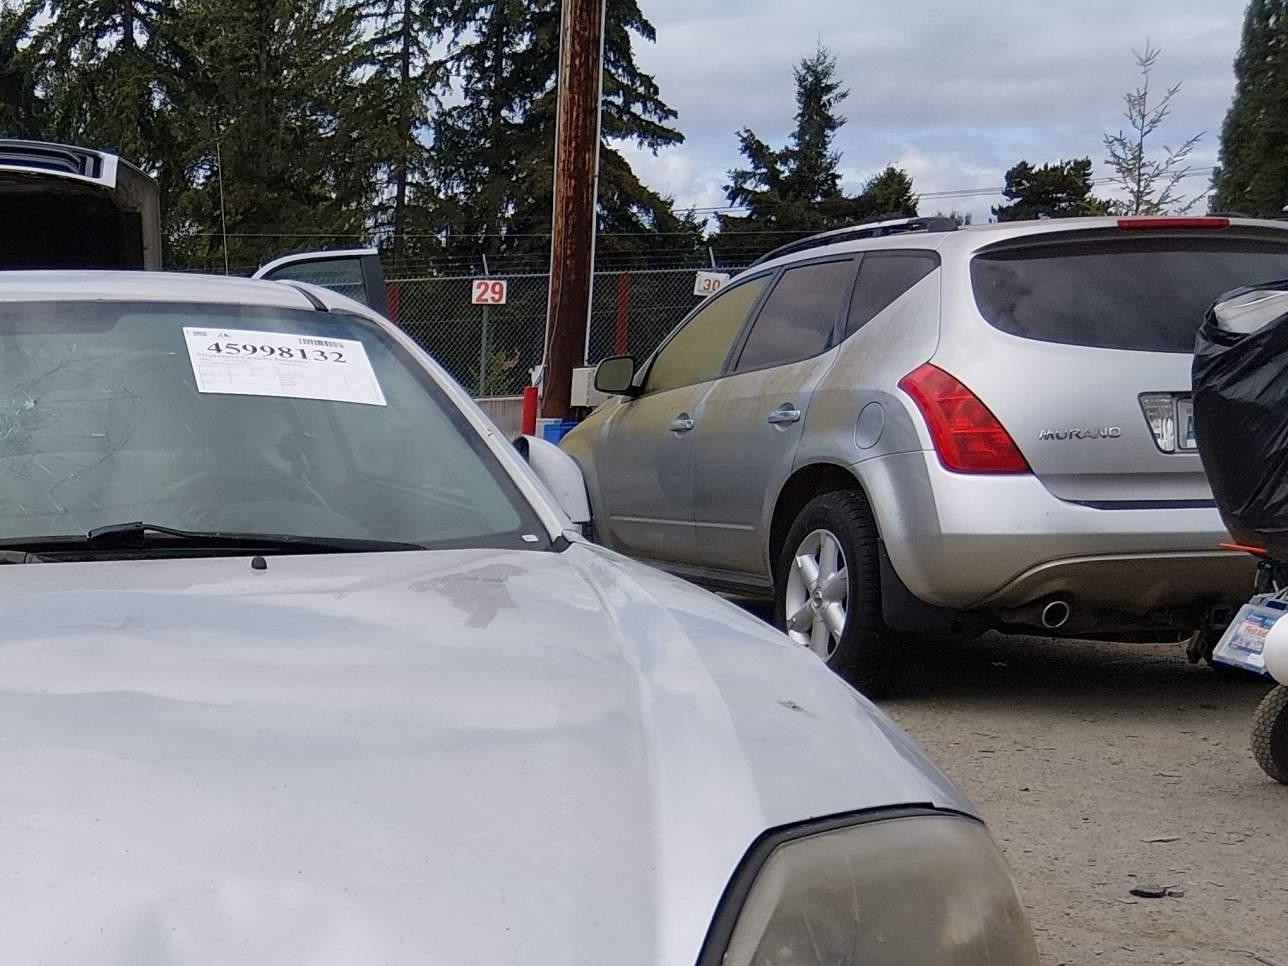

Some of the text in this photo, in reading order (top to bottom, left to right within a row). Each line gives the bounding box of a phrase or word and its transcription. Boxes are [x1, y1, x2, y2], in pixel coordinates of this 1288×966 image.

[476, 281, 504, 303] 29
[703, 279, 721, 291] 30
[207, 342, 347, 363] 45998132
[1039, 427, 1121, 440] MURANO
